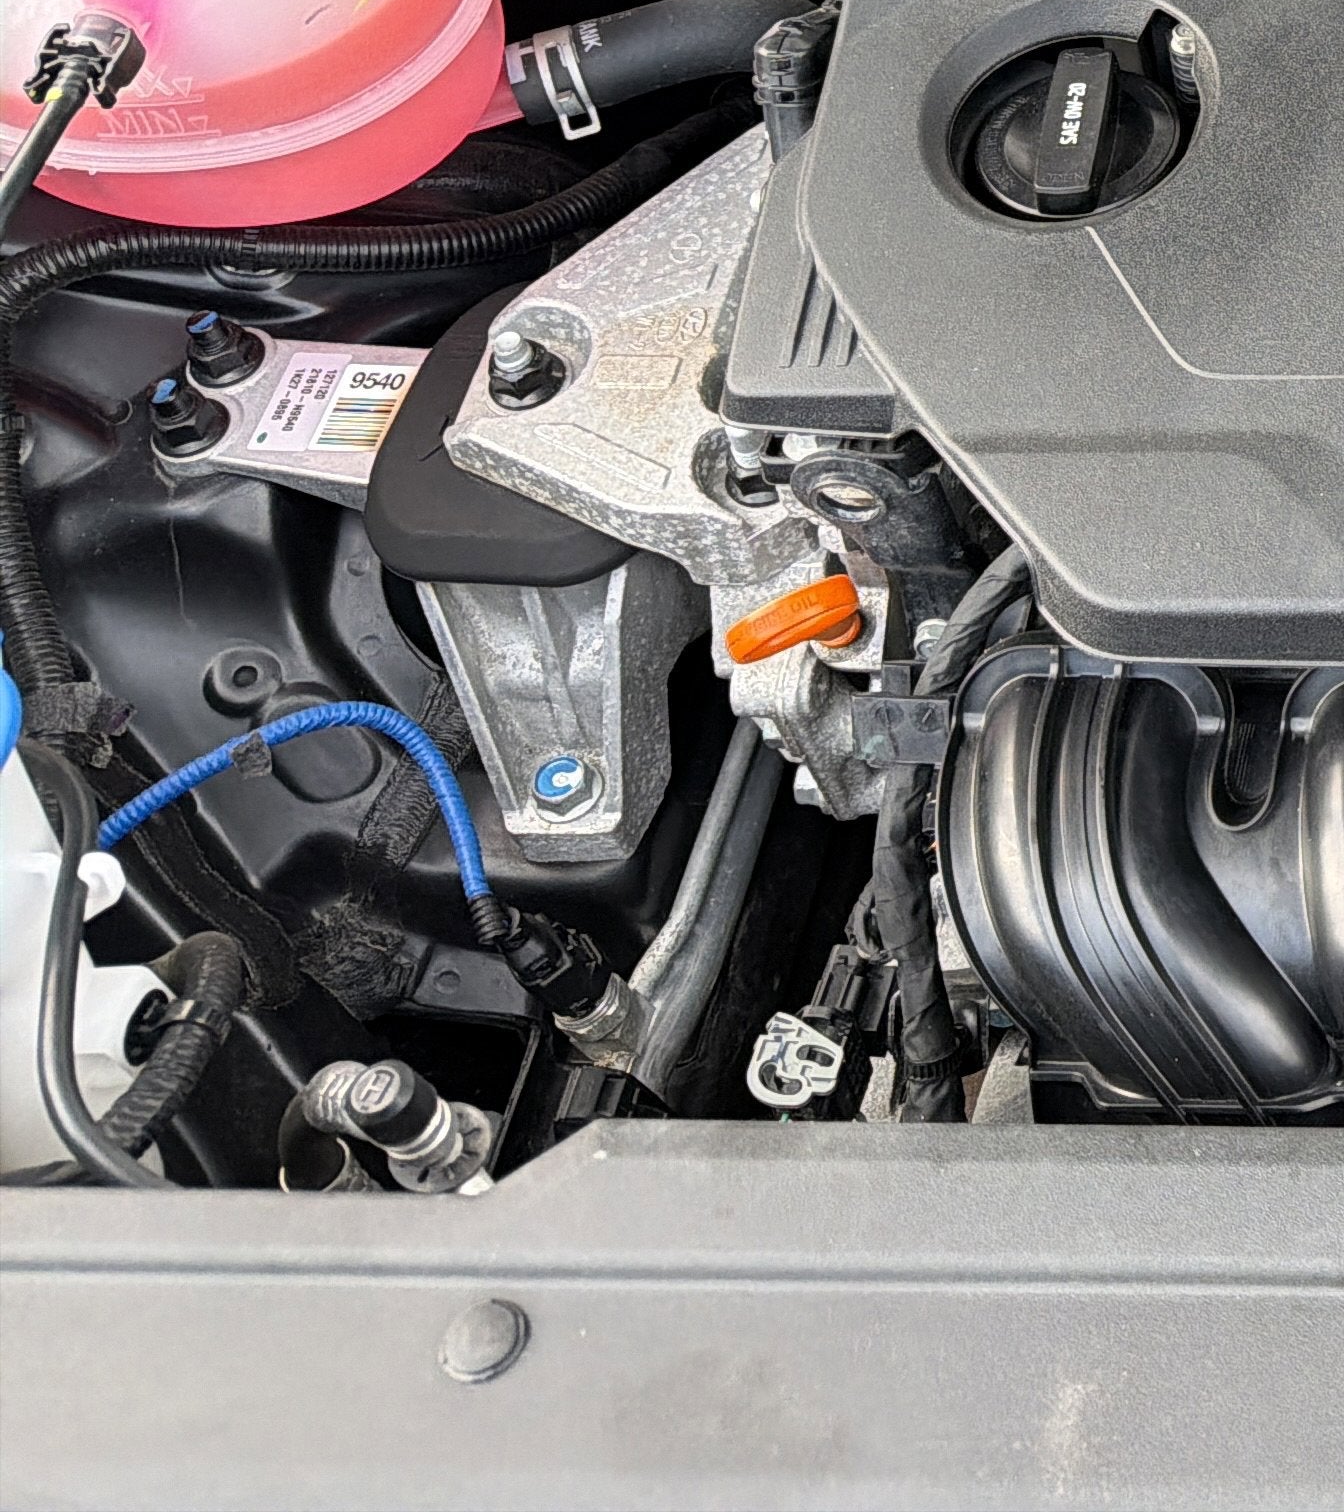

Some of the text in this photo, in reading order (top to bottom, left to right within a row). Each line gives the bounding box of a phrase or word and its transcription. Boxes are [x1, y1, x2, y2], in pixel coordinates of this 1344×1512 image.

[579, 23, 603, 53] ANK
[1059, 120, 1081, 146] SAE
[313, 368, 338, 401] 127120
[349, 371, 406, 391] 9540
